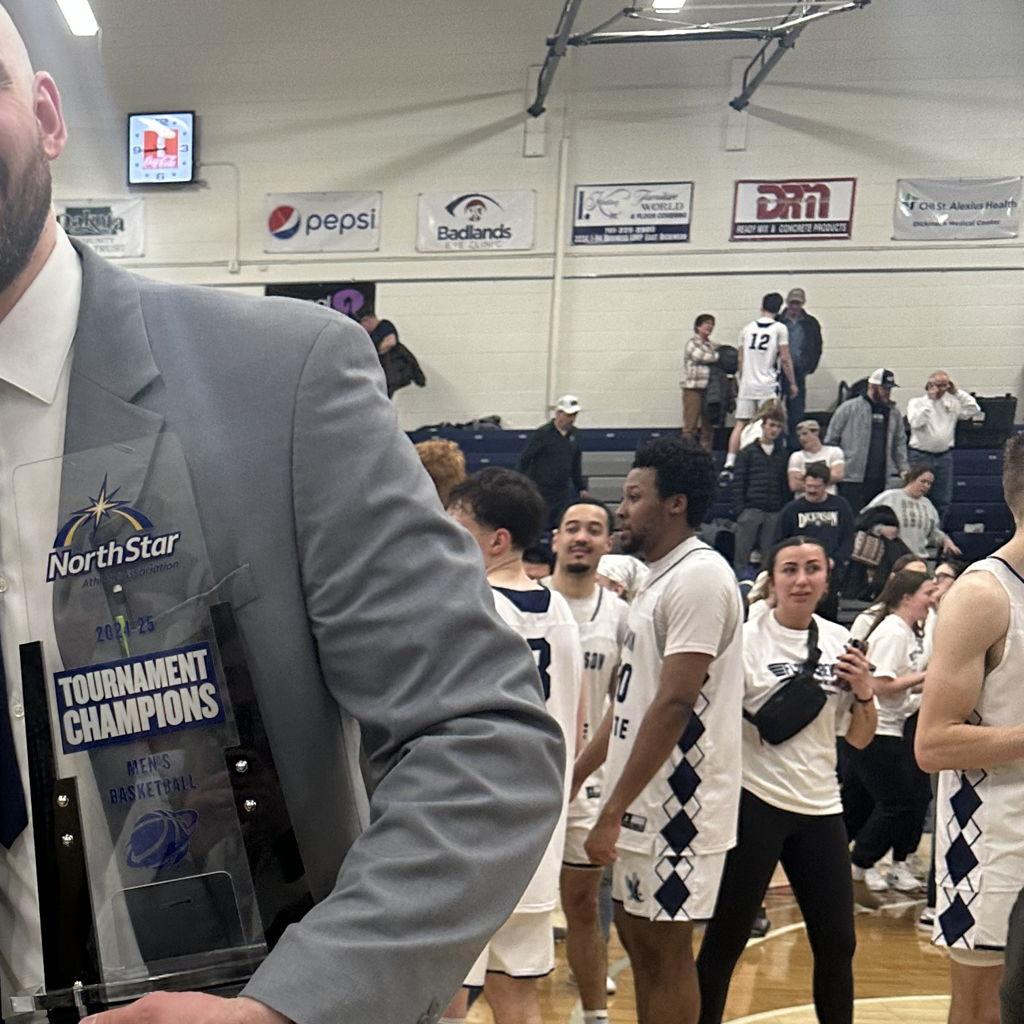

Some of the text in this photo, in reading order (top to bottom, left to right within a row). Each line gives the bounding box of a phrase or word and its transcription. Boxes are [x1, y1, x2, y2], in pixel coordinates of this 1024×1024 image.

[986, 200, 1017, 209] Health
[305, 208, 376, 236] pepsi
[437, 224, 512, 241] Badlands
[749, 333, 771, 350] 12
[58, 649, 208, 707] TOURNAMENT
[63, 683, 219, 746] CHAMPIONS
[109, 774, 198, 804] BASKETBALL
